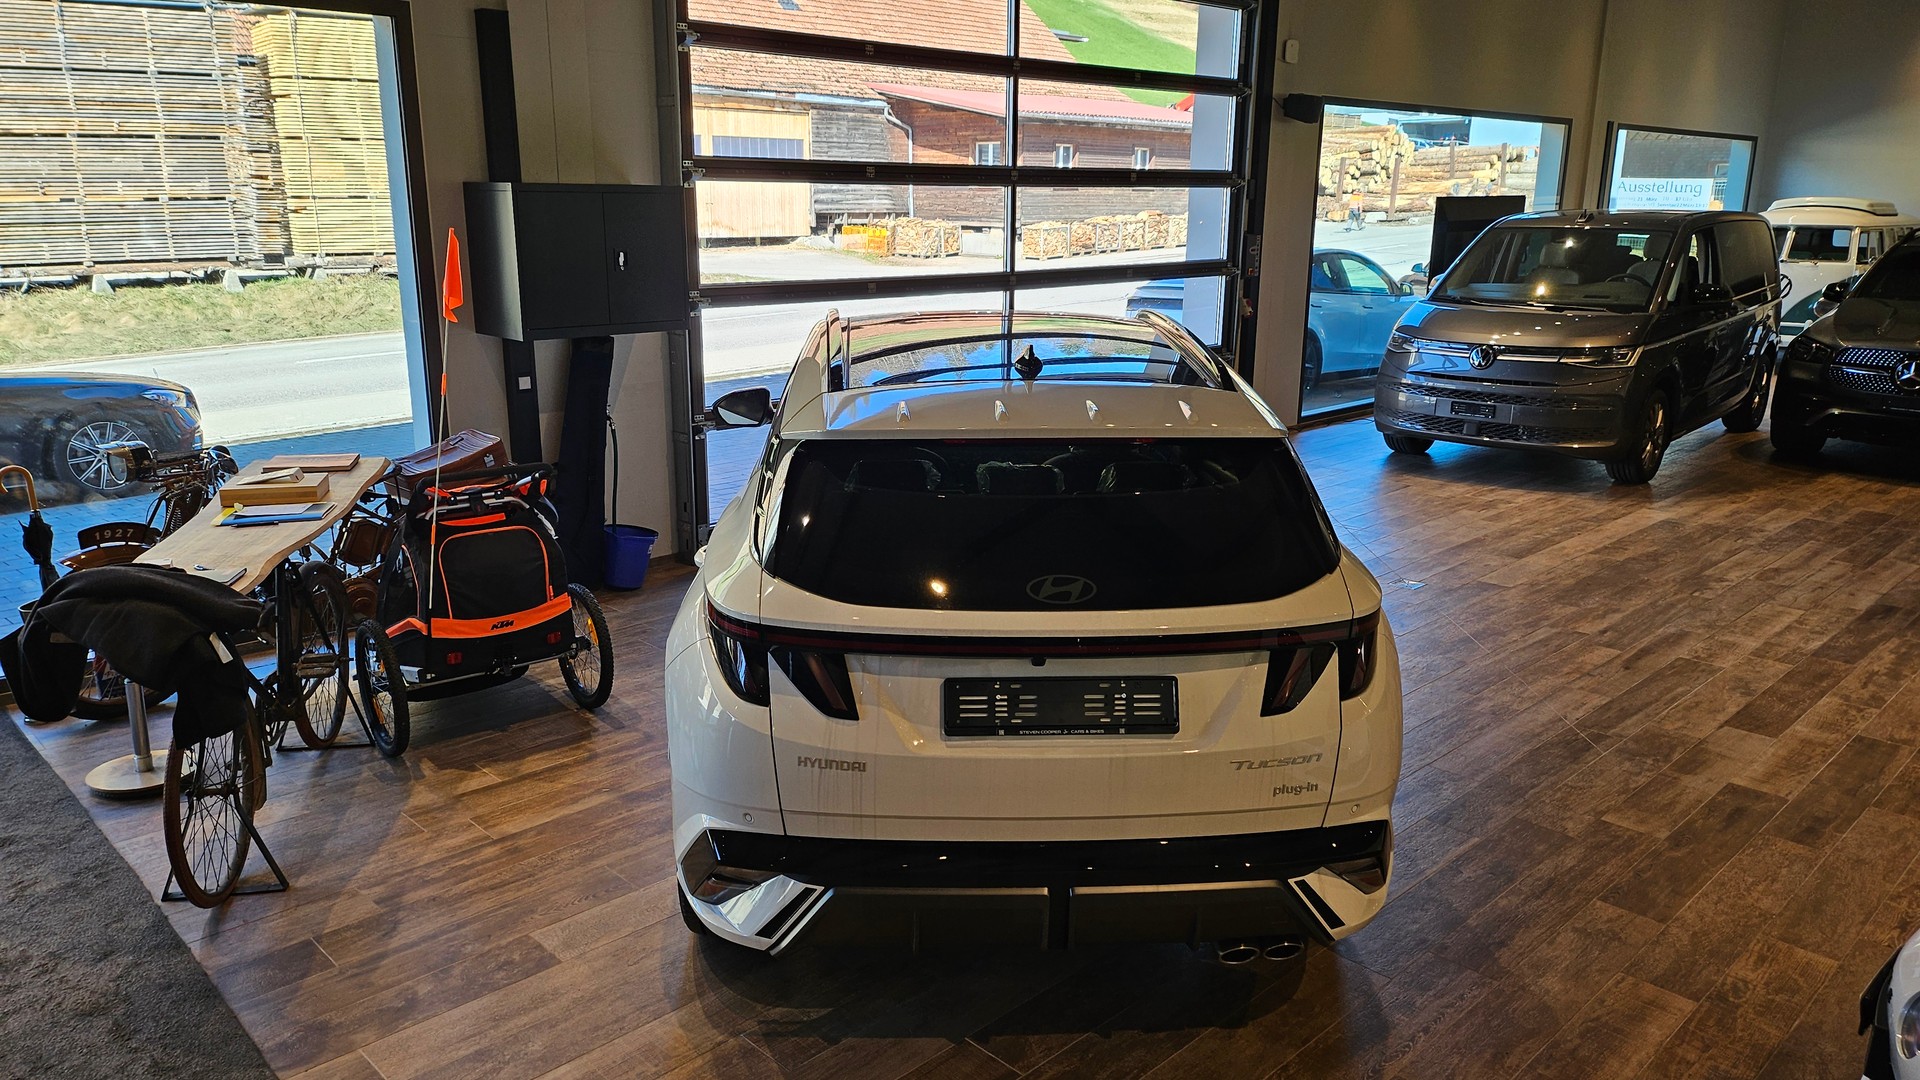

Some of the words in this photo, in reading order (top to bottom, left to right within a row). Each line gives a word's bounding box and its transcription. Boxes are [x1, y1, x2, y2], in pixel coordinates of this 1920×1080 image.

[1619, 181, 1702, 197] Ausstellung
[94, 528, 134, 540] 1927
[490, 619, 515, 631] KTM
[797, 755, 867, 773] HYUNDAI
[1272, 781, 1319, 798] plug-in
